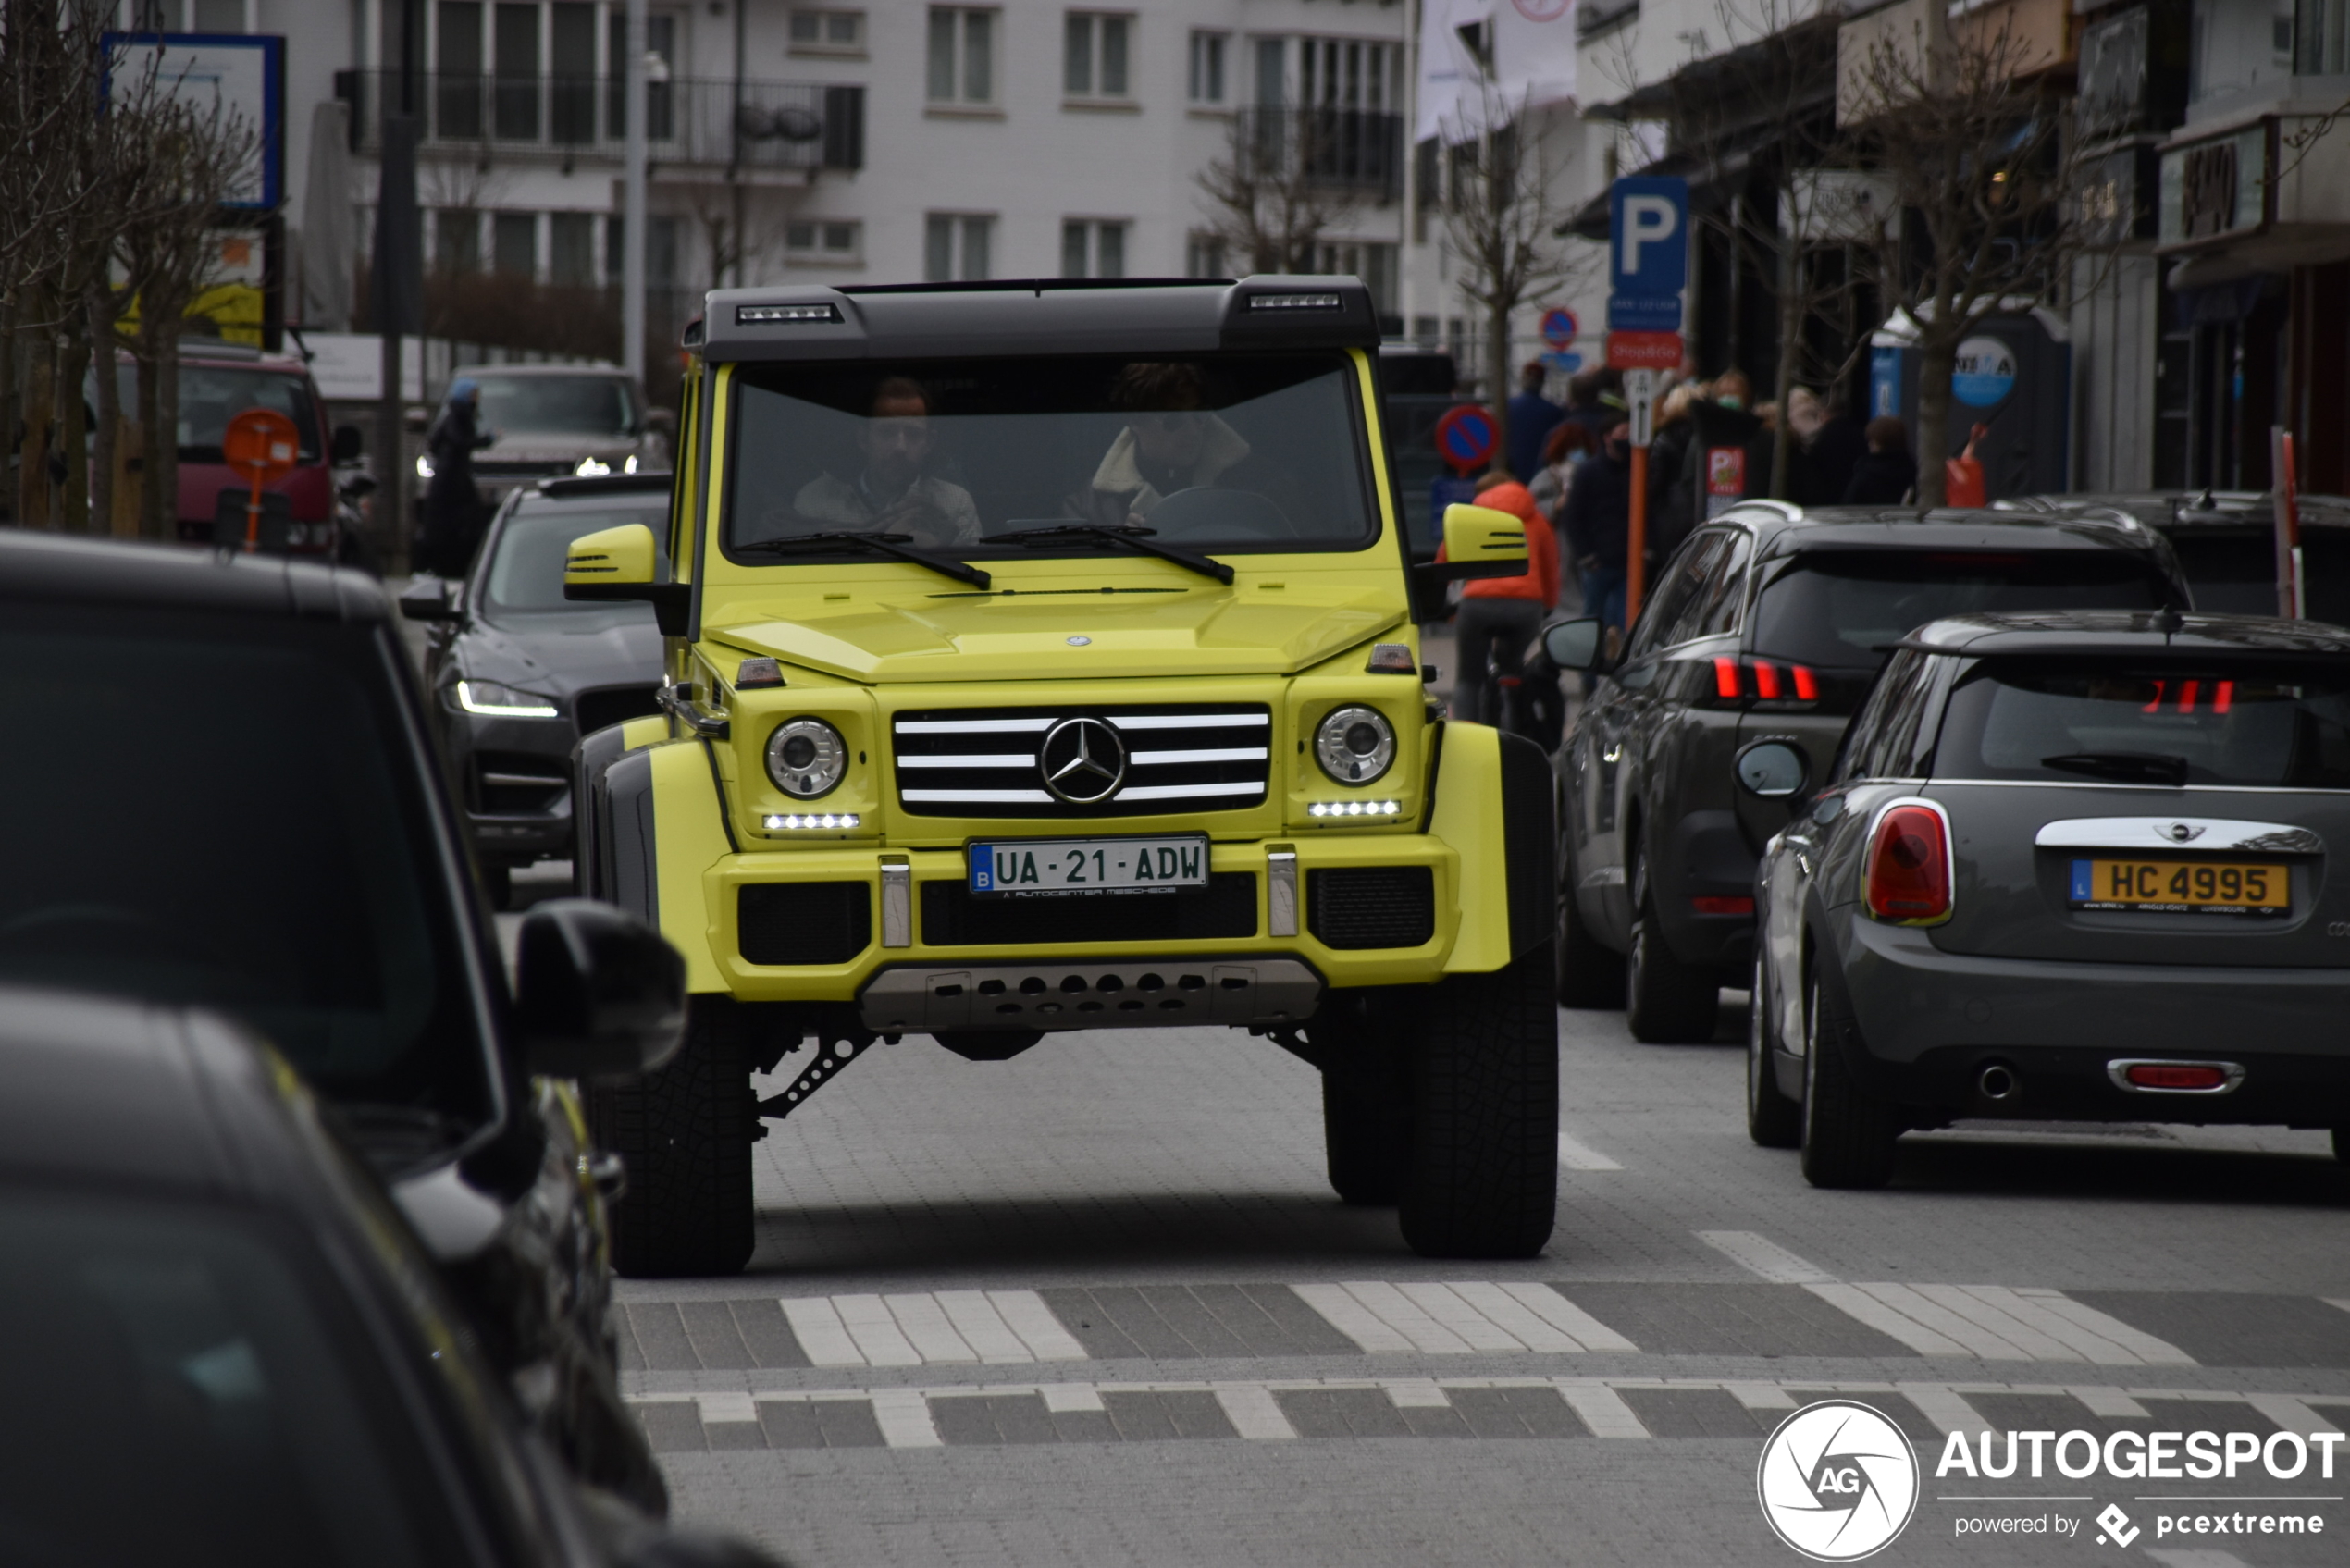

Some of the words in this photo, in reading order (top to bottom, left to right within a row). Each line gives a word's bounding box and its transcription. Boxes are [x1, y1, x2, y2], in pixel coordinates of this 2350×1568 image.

[1622, 195, 1678, 275] P
[1612, 343, 1676, 359] Shop&Go
[977, 872, 989, 887] B
[2111, 865, 2158, 898] HC
[2169, 867, 2267, 902] 4995
[1016, 888, 1102, 897] AUTOCENTER
[2078, 883, 2085, 895] L
